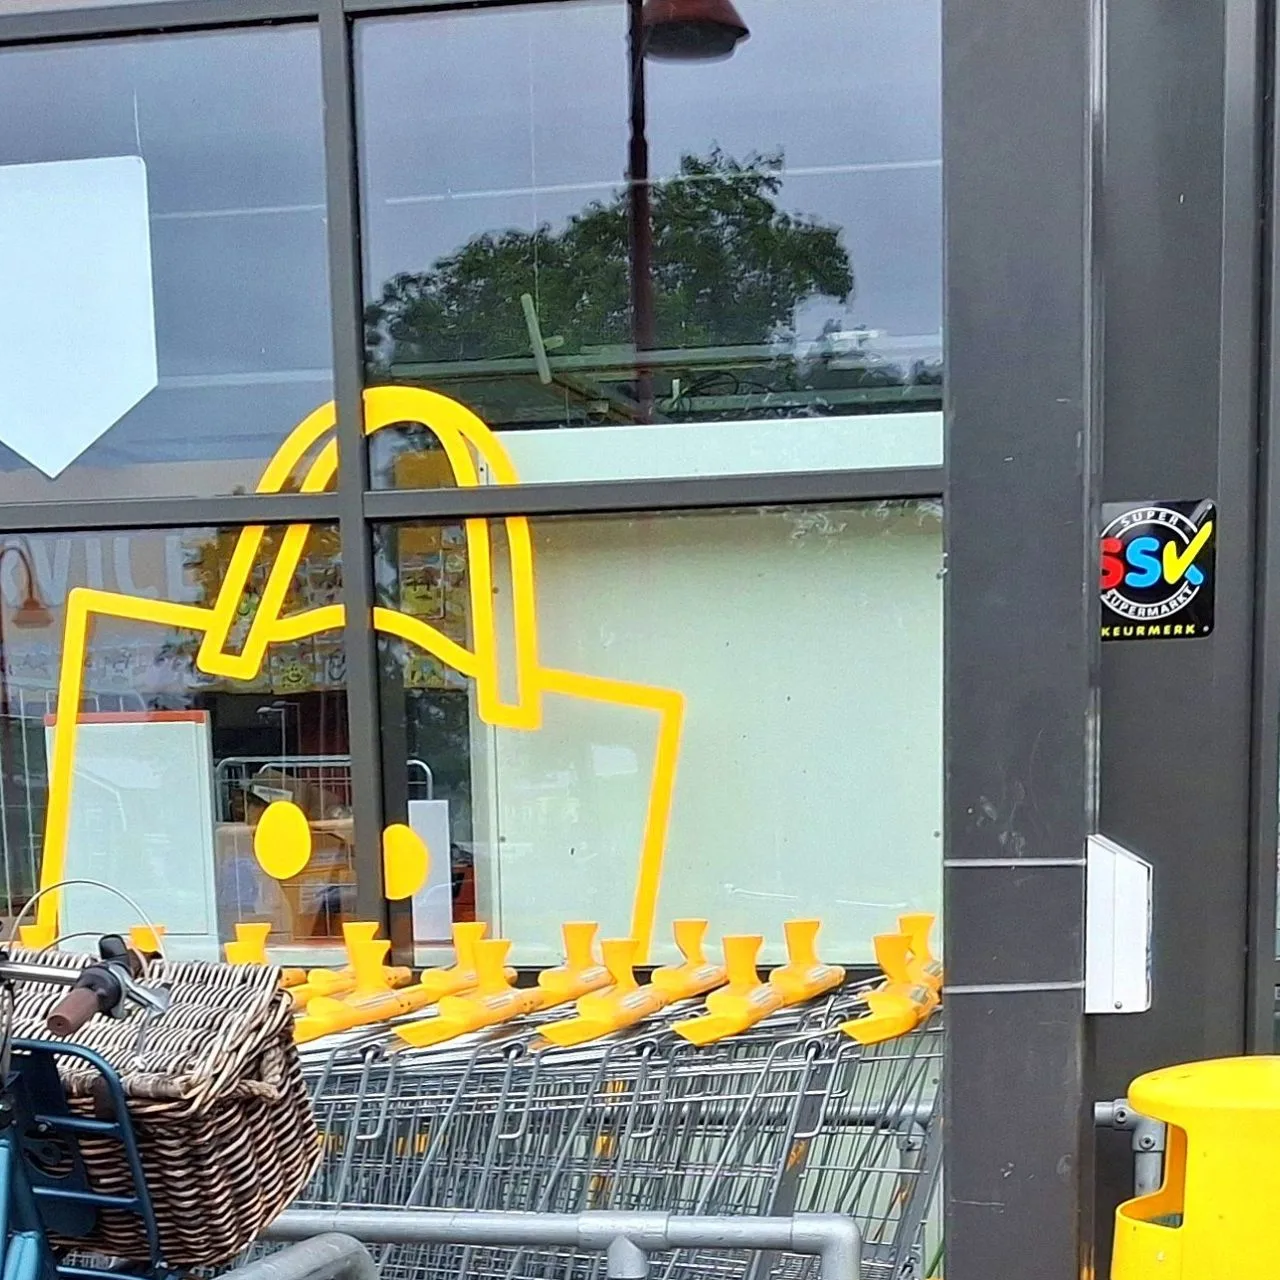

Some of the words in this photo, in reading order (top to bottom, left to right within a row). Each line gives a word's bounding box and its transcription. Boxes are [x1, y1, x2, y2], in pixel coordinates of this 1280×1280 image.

[1120, 510, 1179, 527] SUPER
[1104, 586, 1194, 617] SUPERMARKT
[1101, 624, 1195, 637] KEURMERK
